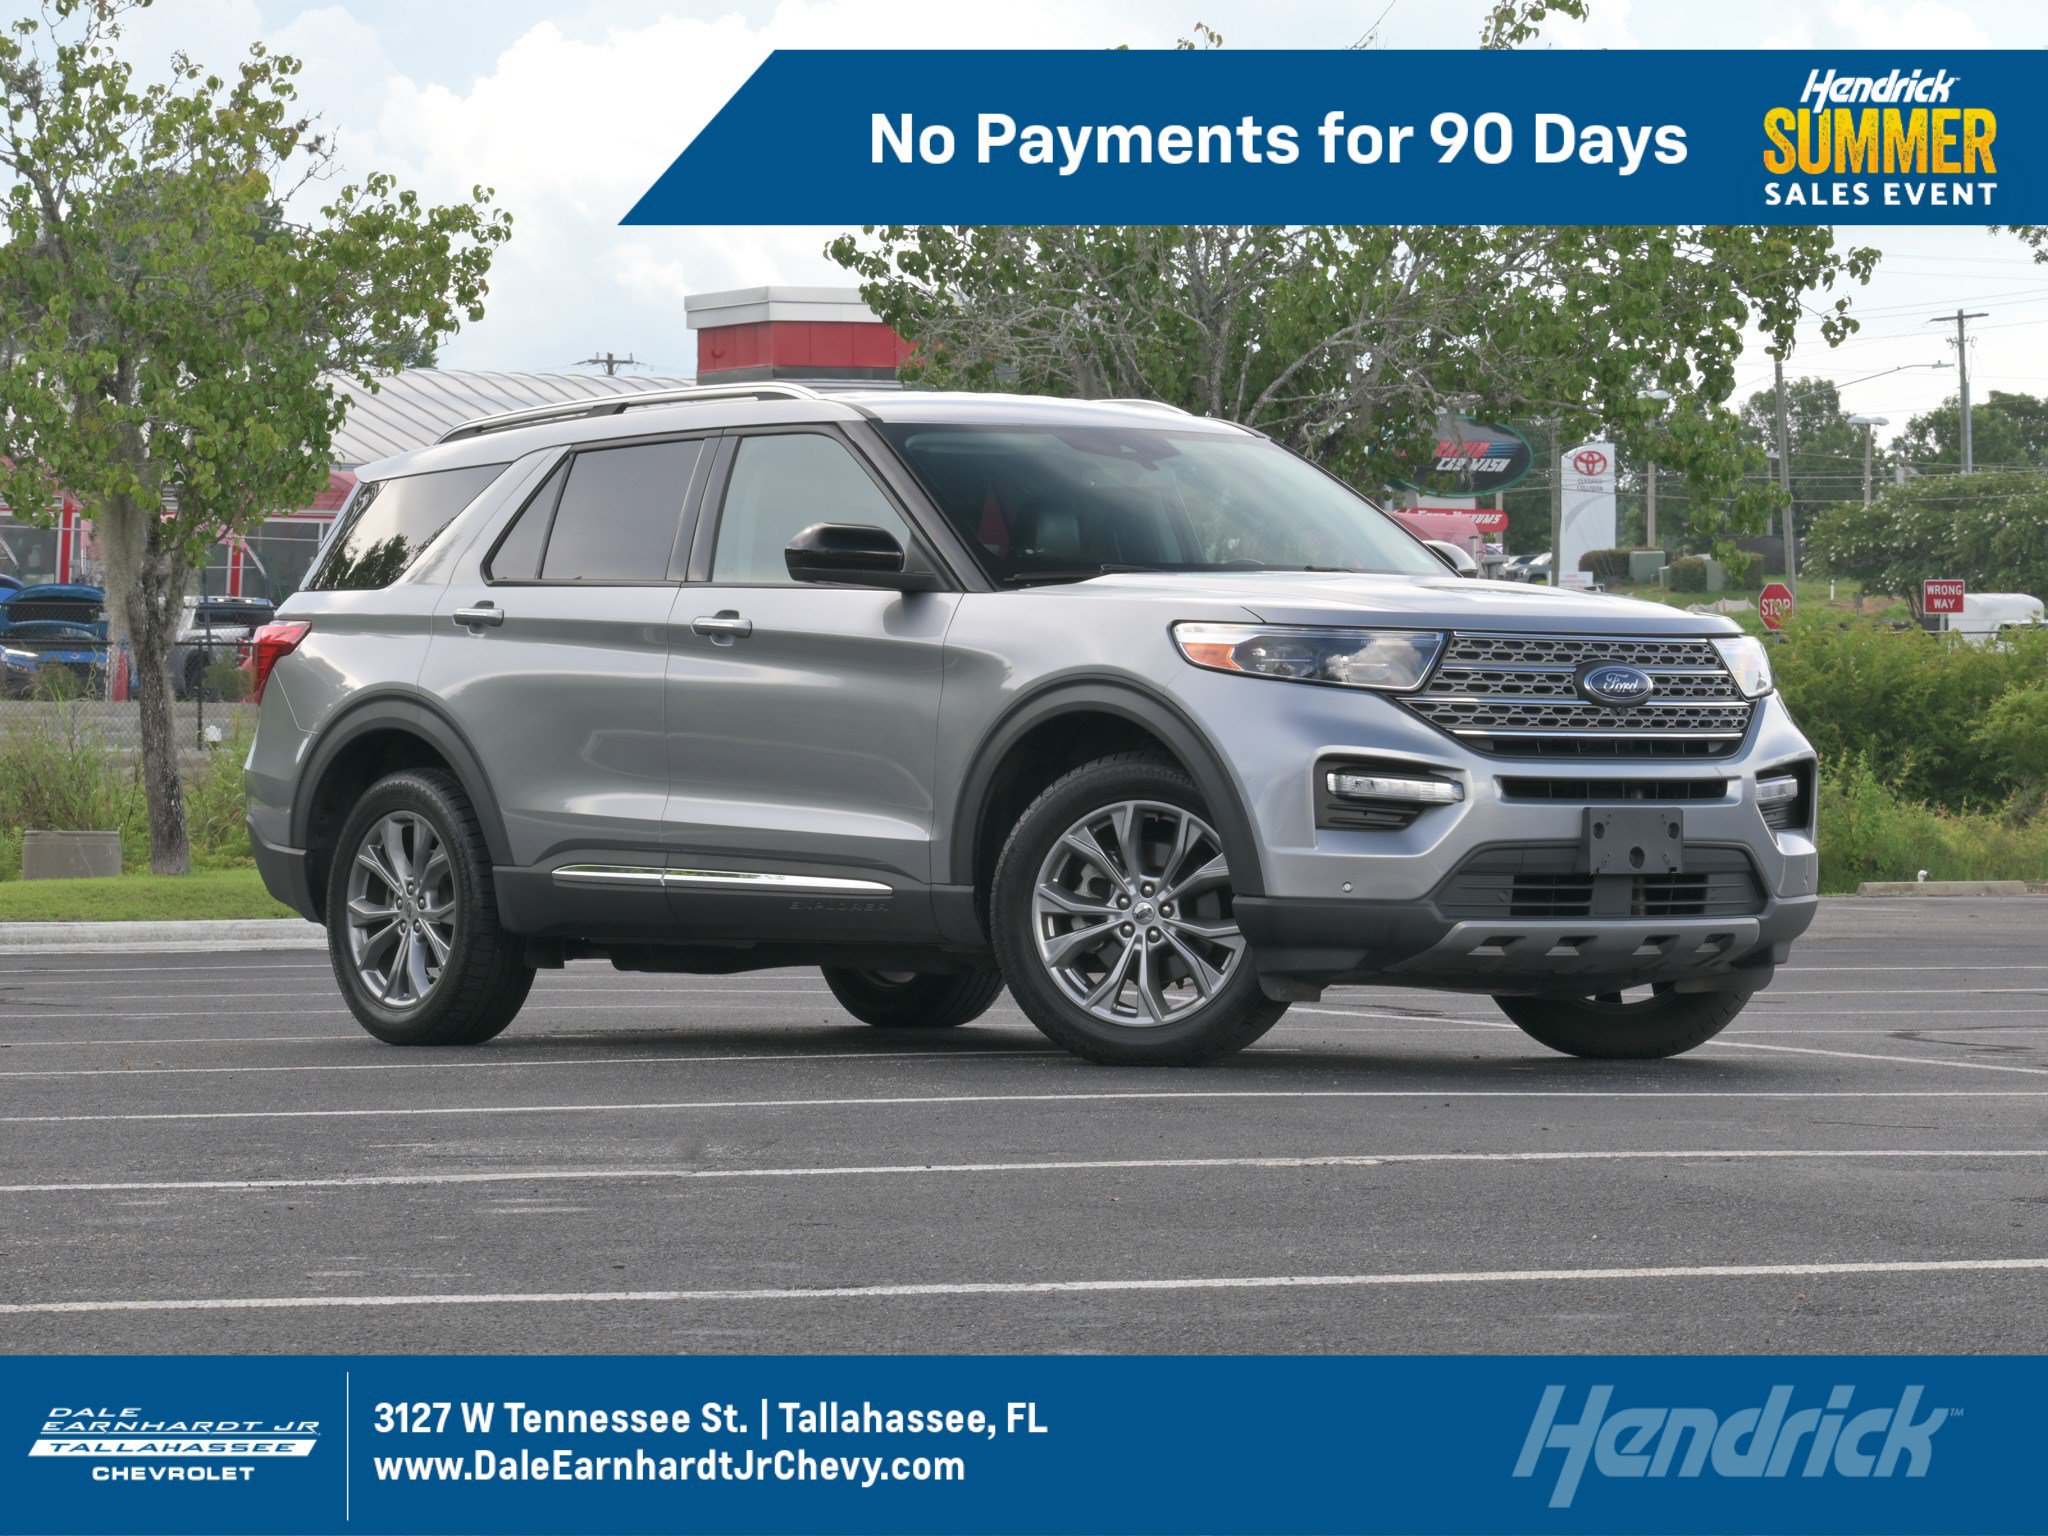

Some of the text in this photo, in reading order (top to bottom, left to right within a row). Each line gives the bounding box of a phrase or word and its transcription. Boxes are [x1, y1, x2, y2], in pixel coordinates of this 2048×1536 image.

[1469, 458, 1511, 472] WASH
[1926, 585, 1962, 596] WRONG
[1761, 598, 1791, 616] STOP
[1933, 598, 1956, 609] WAY
[1603, 672, 1638, 693] Ford
